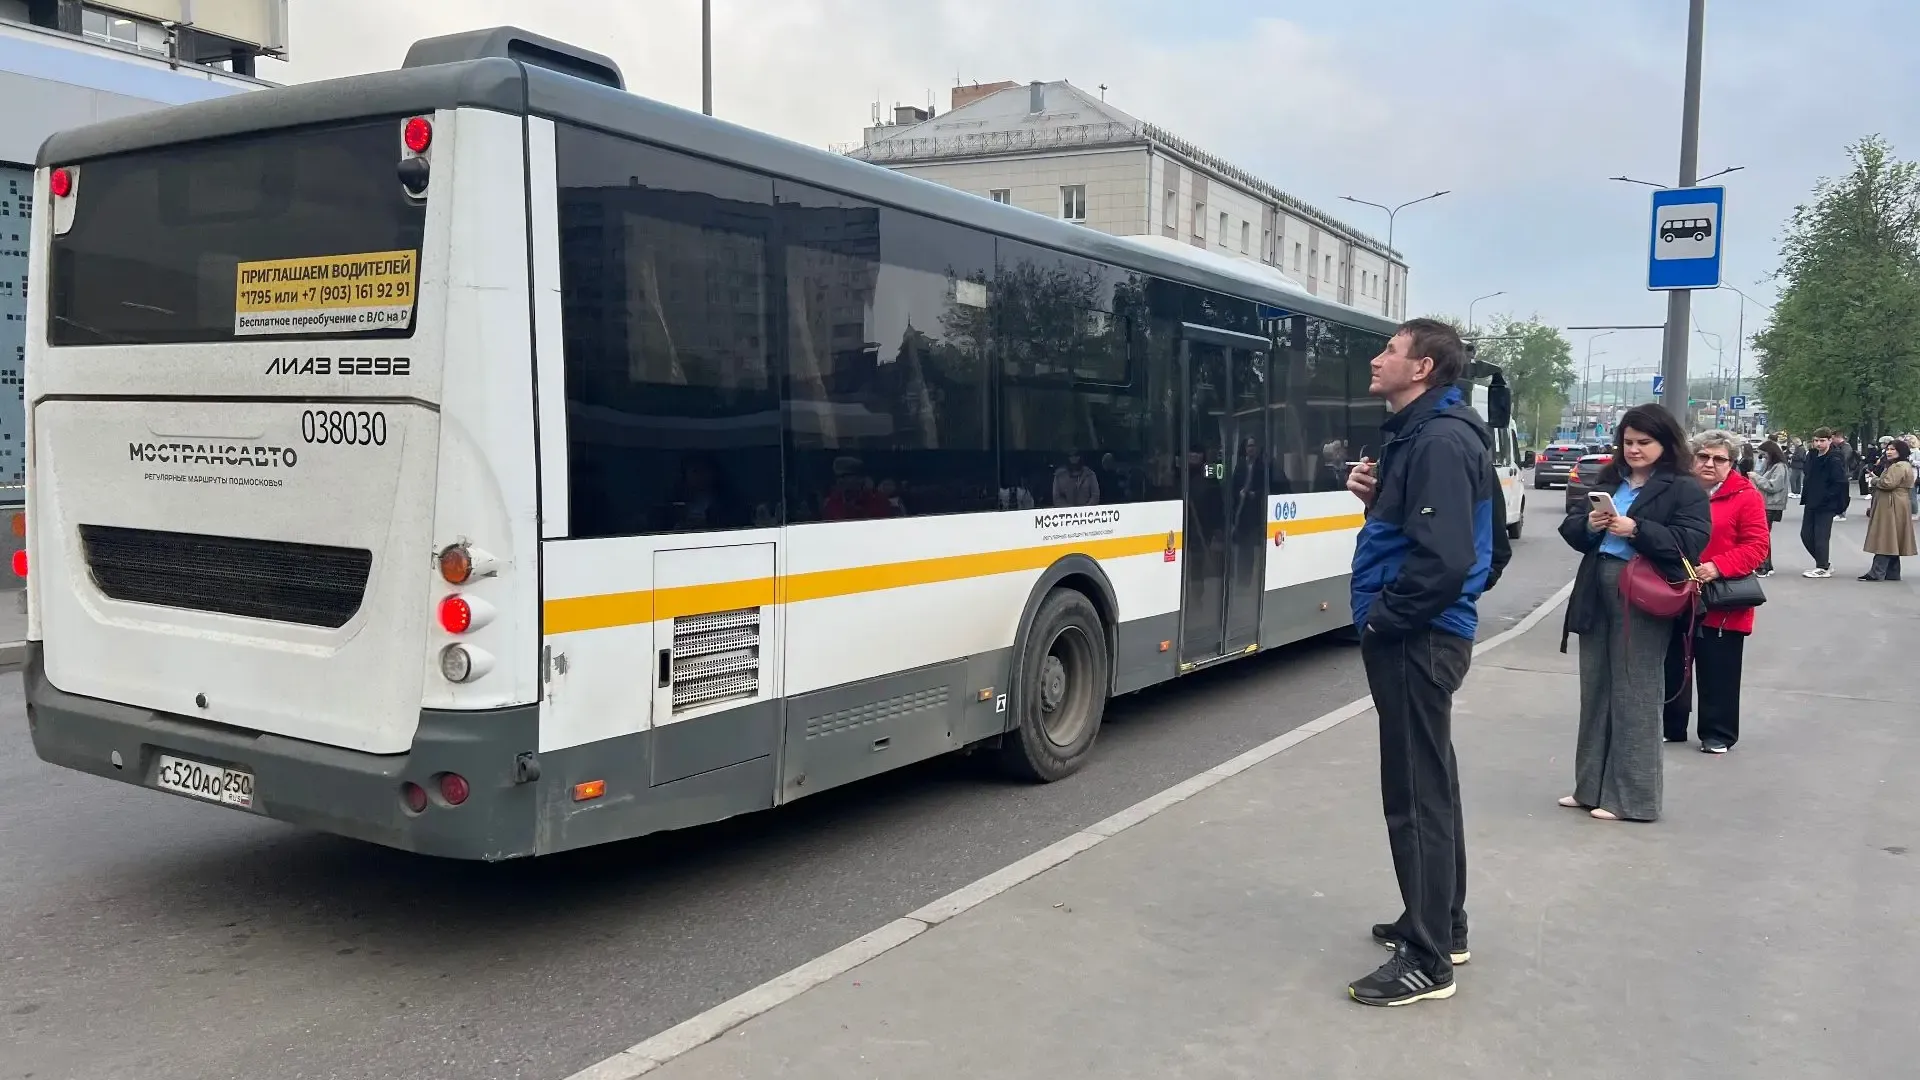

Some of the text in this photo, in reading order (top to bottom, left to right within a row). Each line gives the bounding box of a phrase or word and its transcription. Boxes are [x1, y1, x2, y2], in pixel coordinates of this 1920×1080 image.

[241, 255, 411, 284] ПРИГЛАШАЕМ ВОДИТЕЛЕЙ
[274, 291, 299, 304] или
[302, 287, 317, 302] +7
[320, 285, 351, 304] (903)
[356, 284, 373, 299] 161
[377, 282, 393, 298] 92
[397, 281, 410, 297] 91
[239, 316, 290, 328] Бесплатное
[292, 313, 356, 330] переобучение
[386, 313, 399, 322] на
[401, 310, 408, 320] D
[265, 357, 411, 375] ЛИАЗ 5292
[302, 410, 387, 446] 038030
[129, 442, 298, 467] МОСТРАНСАВТО
[144, 473, 283, 487] РЕГУЛЯРНЫЕ МАРШРУТЫ ПОДМОСКОВЬЯ
[1035, 510, 1120, 529] МОСТРАНСАВТО
[224, 773, 251, 794] 250
